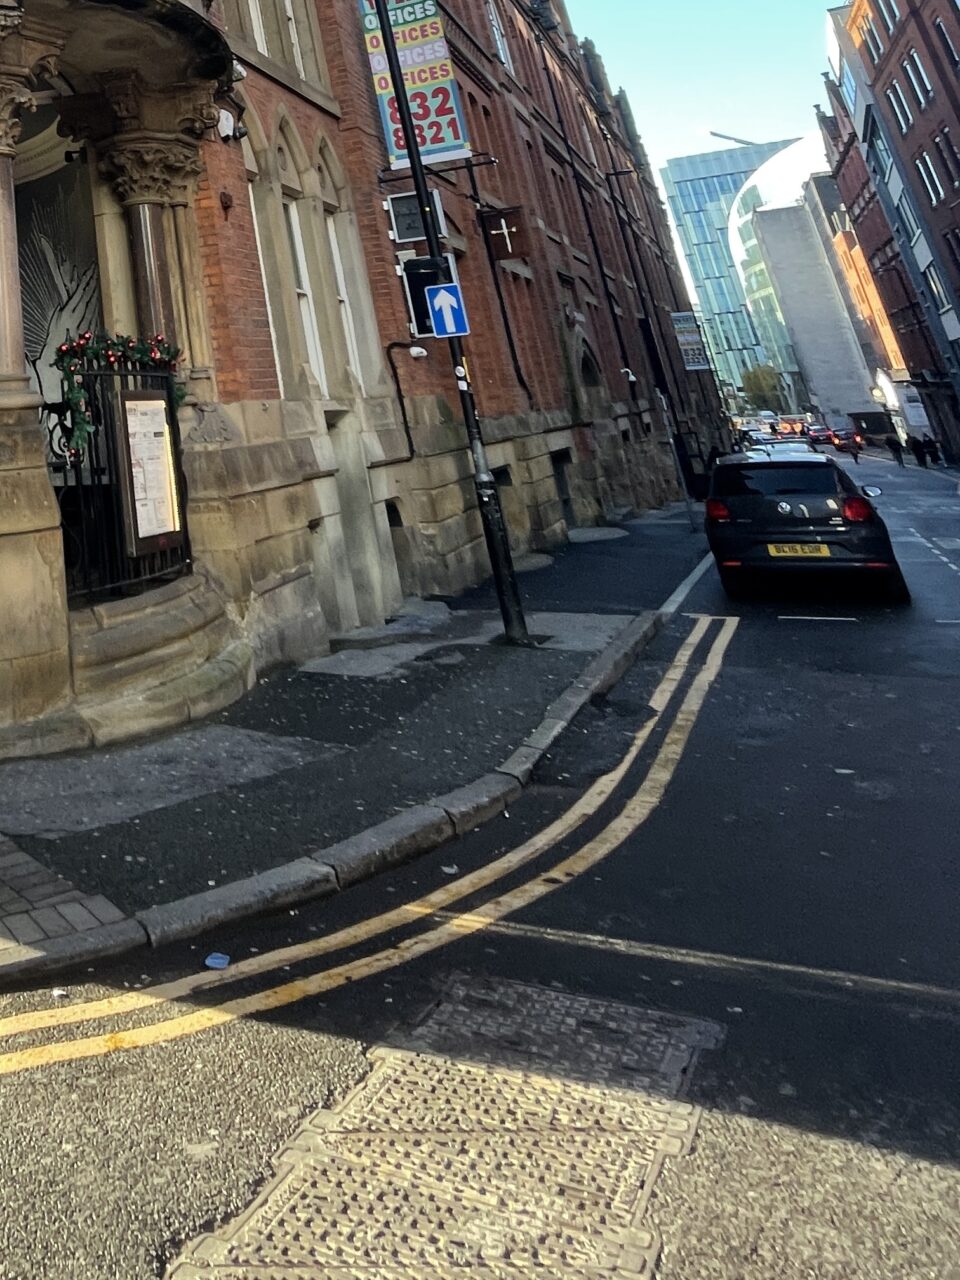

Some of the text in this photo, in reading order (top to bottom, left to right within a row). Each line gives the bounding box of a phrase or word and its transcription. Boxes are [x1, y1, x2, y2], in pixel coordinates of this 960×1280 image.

[364, 0, 437, 30] OFICES
[369, 21, 440, 49] OFICES
[372, 42, 446, 71] OFICES
[377, 63, 450, 91] OFICES
